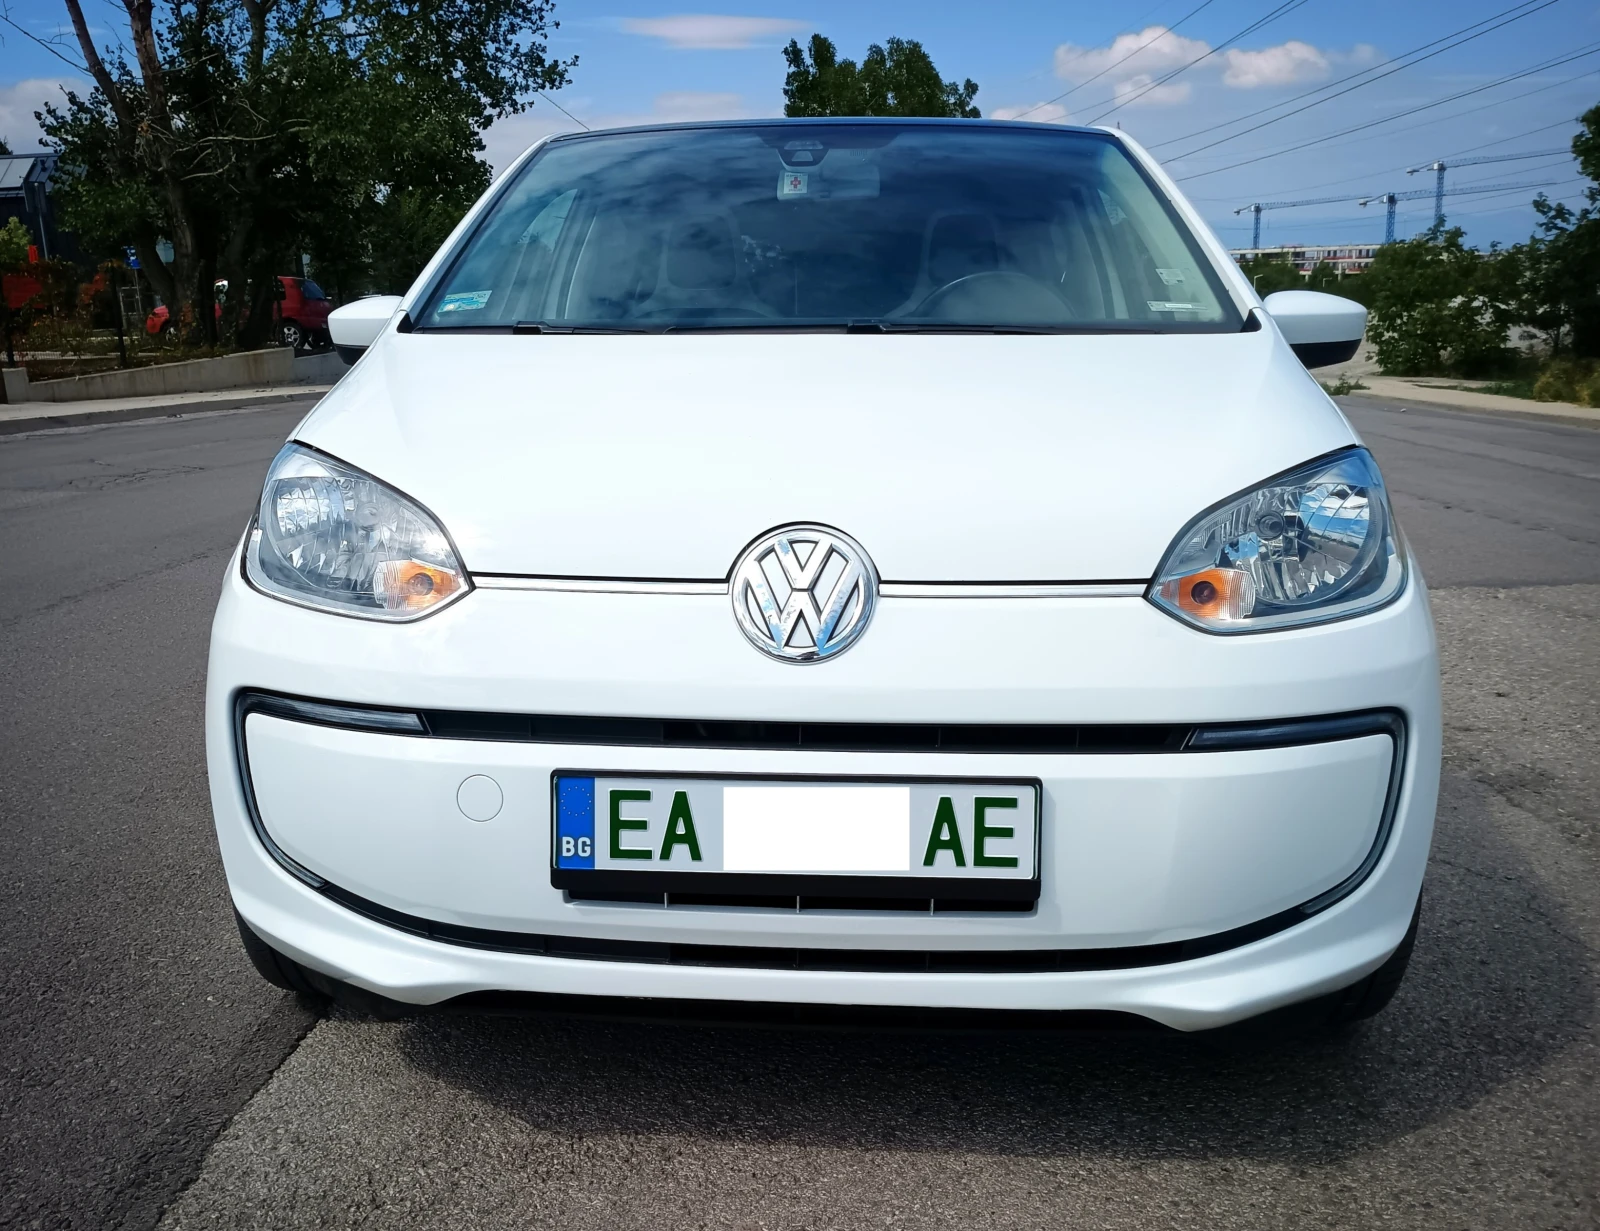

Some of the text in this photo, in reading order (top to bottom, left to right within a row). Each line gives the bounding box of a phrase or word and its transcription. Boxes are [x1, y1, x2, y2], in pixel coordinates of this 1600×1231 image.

[562, 837, 592, 857] BG
[609, 789, 1019, 868] EA AE
